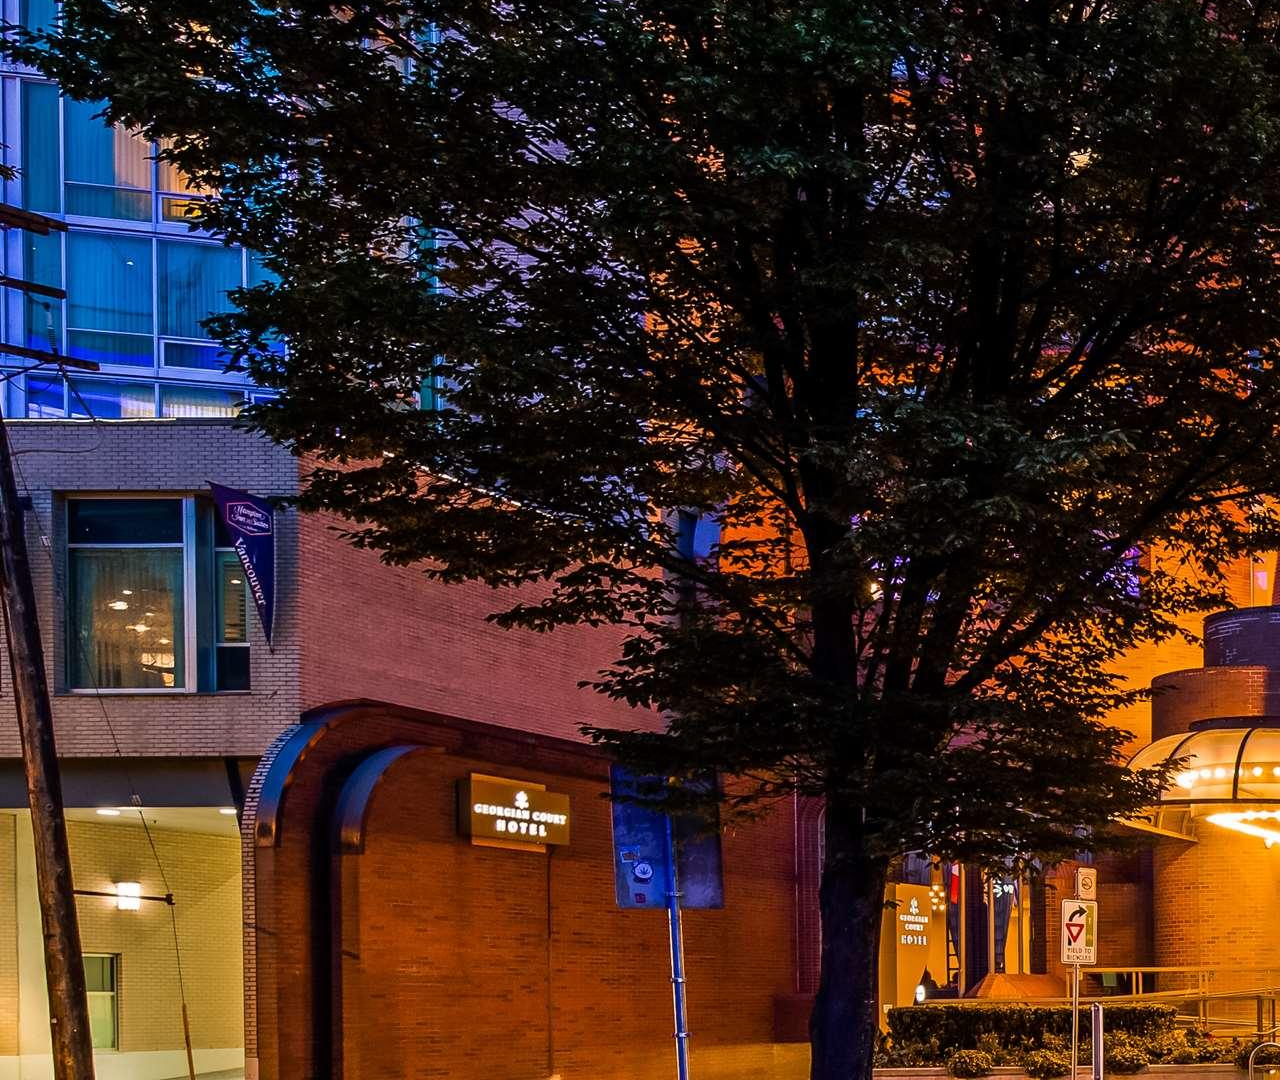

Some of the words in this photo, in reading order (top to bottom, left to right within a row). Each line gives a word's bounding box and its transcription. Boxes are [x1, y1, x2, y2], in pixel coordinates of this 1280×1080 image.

[235, 537, 266, 608] Vancouver
[474, 803, 530, 820] GEORGIAN
[532, 811, 567, 825] COURT
[496, 819, 547, 837] HOTEL
[901, 934, 927, 946] HOTEL
